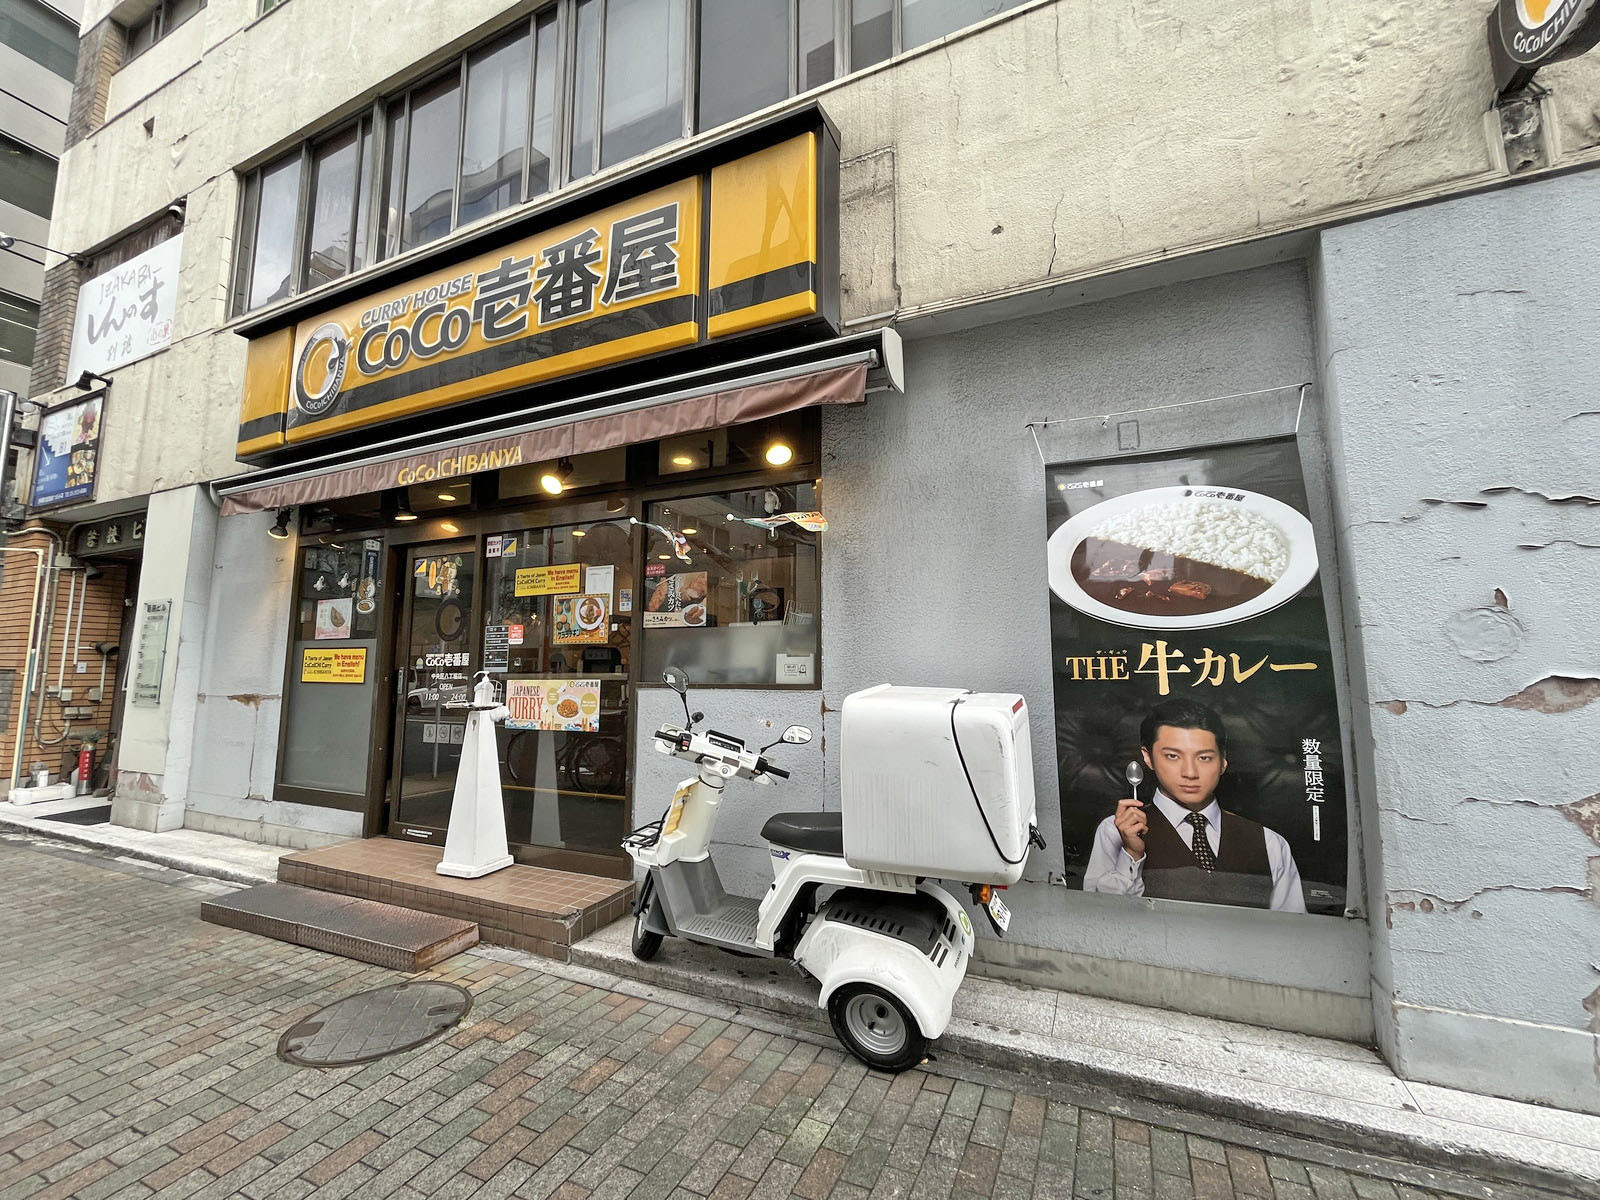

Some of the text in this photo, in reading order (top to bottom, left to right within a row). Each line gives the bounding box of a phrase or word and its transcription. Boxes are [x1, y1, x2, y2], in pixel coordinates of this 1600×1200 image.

[356, 202, 680, 376] CoCo壱番屋
[360, 273, 474, 329] CURRY HOUSE
[513, 685, 540, 697] JAPANESE
[1065, 640, 1318, 696] THE 牛カレー
[425, 693, 440, 701] 11:00
[450, 693, 467, 701] 24:00
[508, 696, 544, 720] CURRY
[1302, 738, 1325, 803] 数量限定
